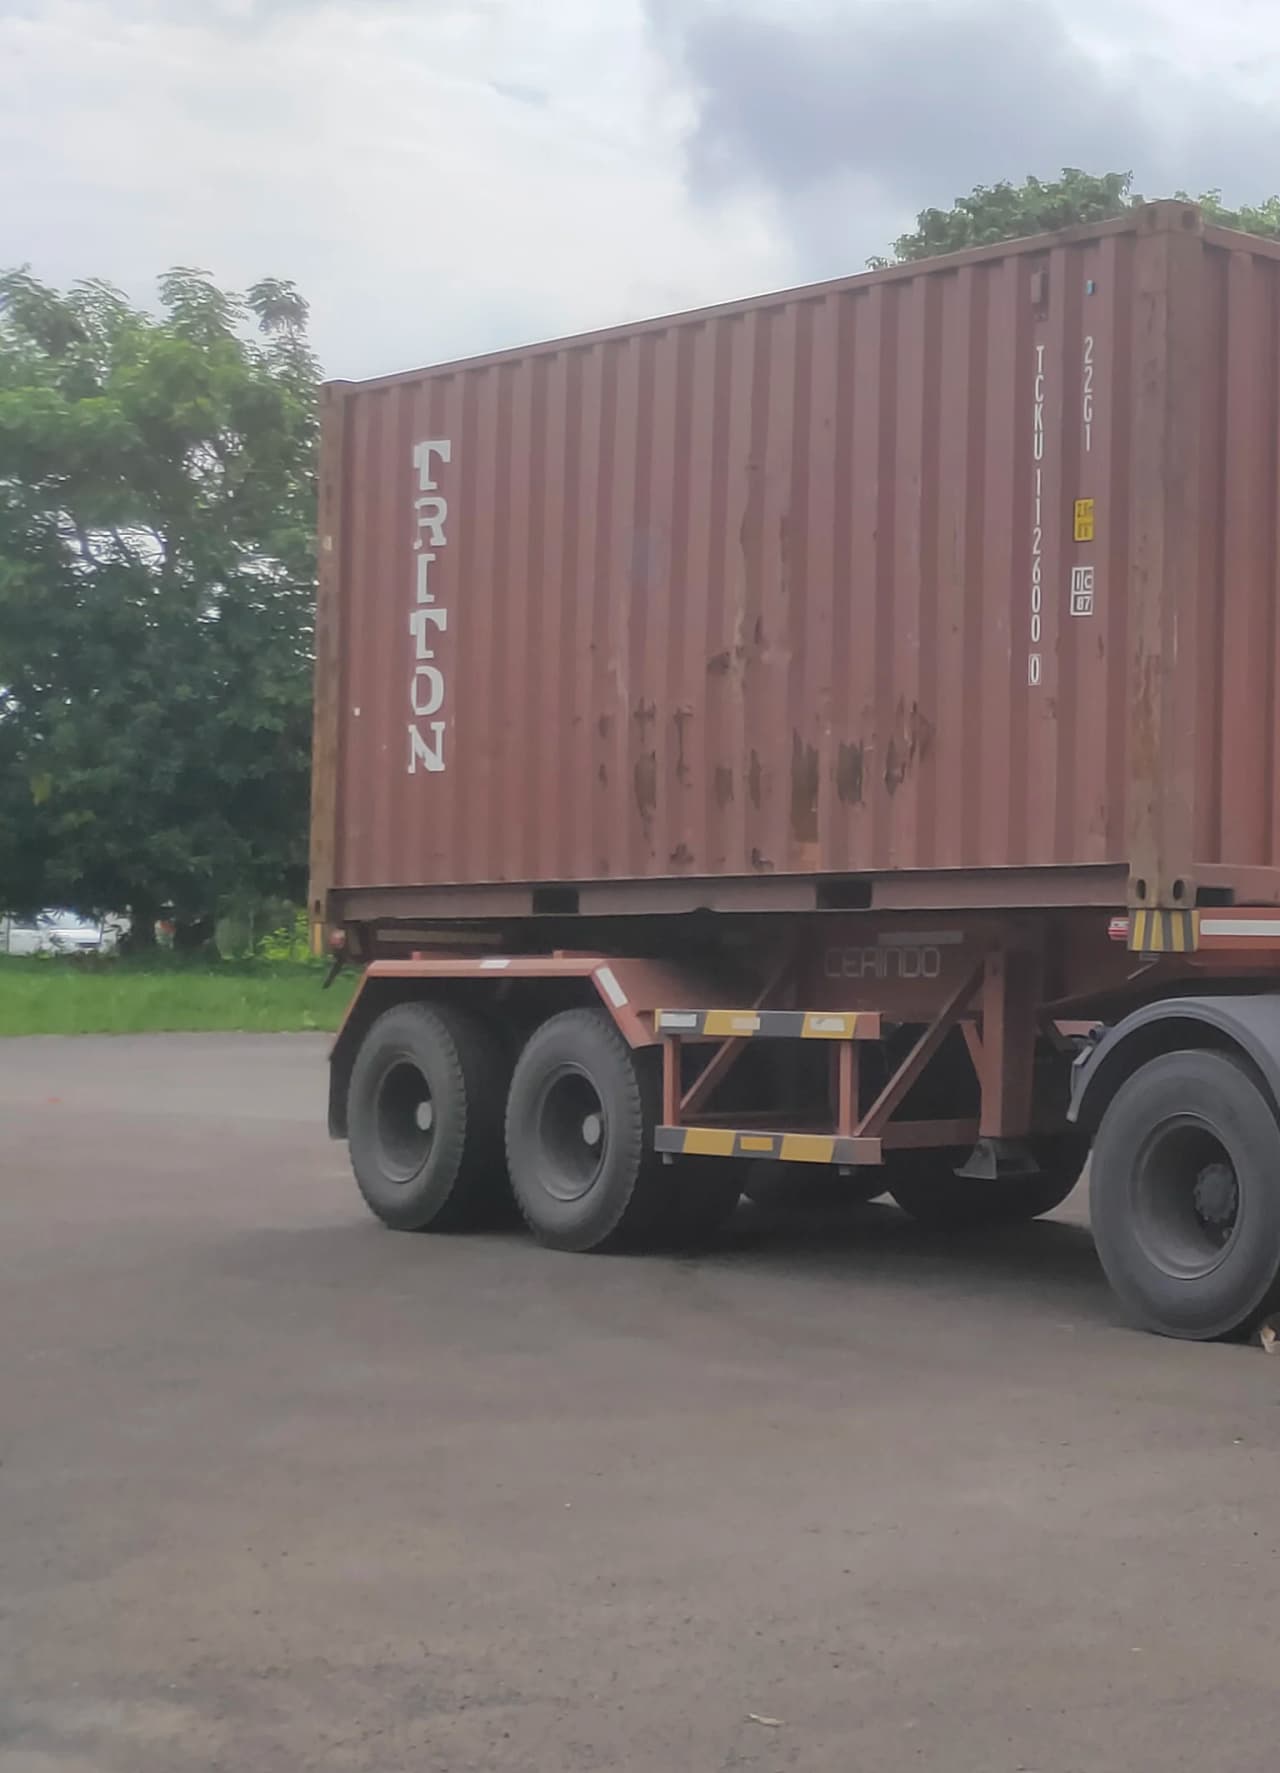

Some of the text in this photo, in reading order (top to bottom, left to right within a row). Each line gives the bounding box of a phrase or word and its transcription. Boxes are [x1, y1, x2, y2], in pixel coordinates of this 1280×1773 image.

[1033, 344, 1045, 460] TCKU
[1083, 335, 1094, 452] 22G1
[408, 440, 451, 773] TRITON
[1030, 468, 1042, 643] 112600
